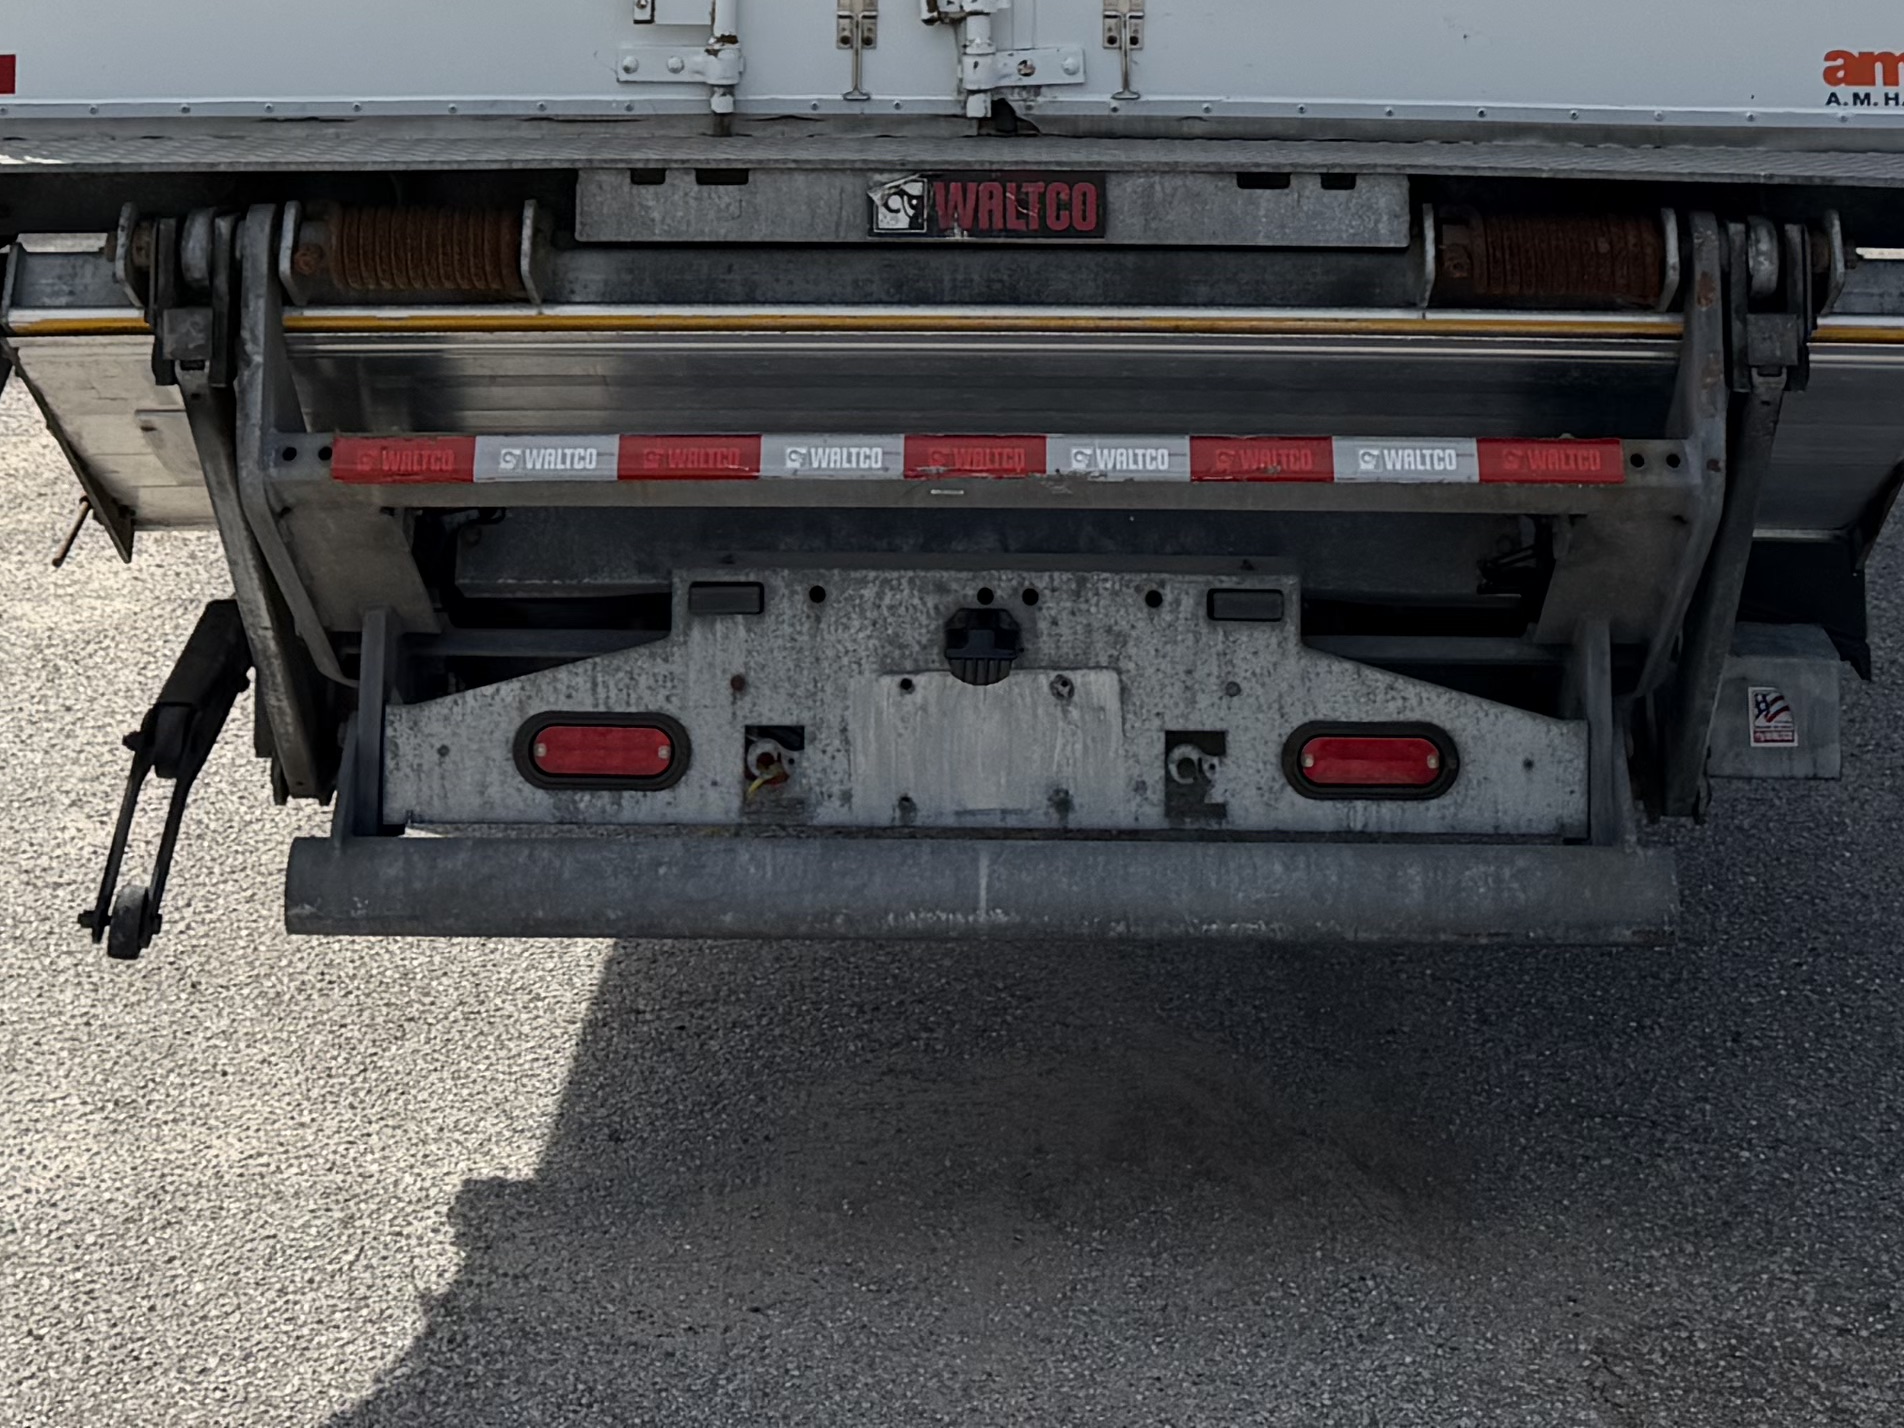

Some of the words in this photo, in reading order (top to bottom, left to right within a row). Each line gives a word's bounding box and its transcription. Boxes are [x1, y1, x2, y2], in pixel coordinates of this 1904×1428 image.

[934, 181, 1098, 232] WALTCO
[381, 448, 455, 473] WALTCO
[525, 448, 597, 470] WALTCO
[668, 447, 741, 469] WALTCO
[811, 447, 883, 469] WALTCO
[1096, 448, 1169, 470] WALTCO
[1384, 449, 1457, 471] WALTCO
[1527, 449, 1601, 471] WALTCO
